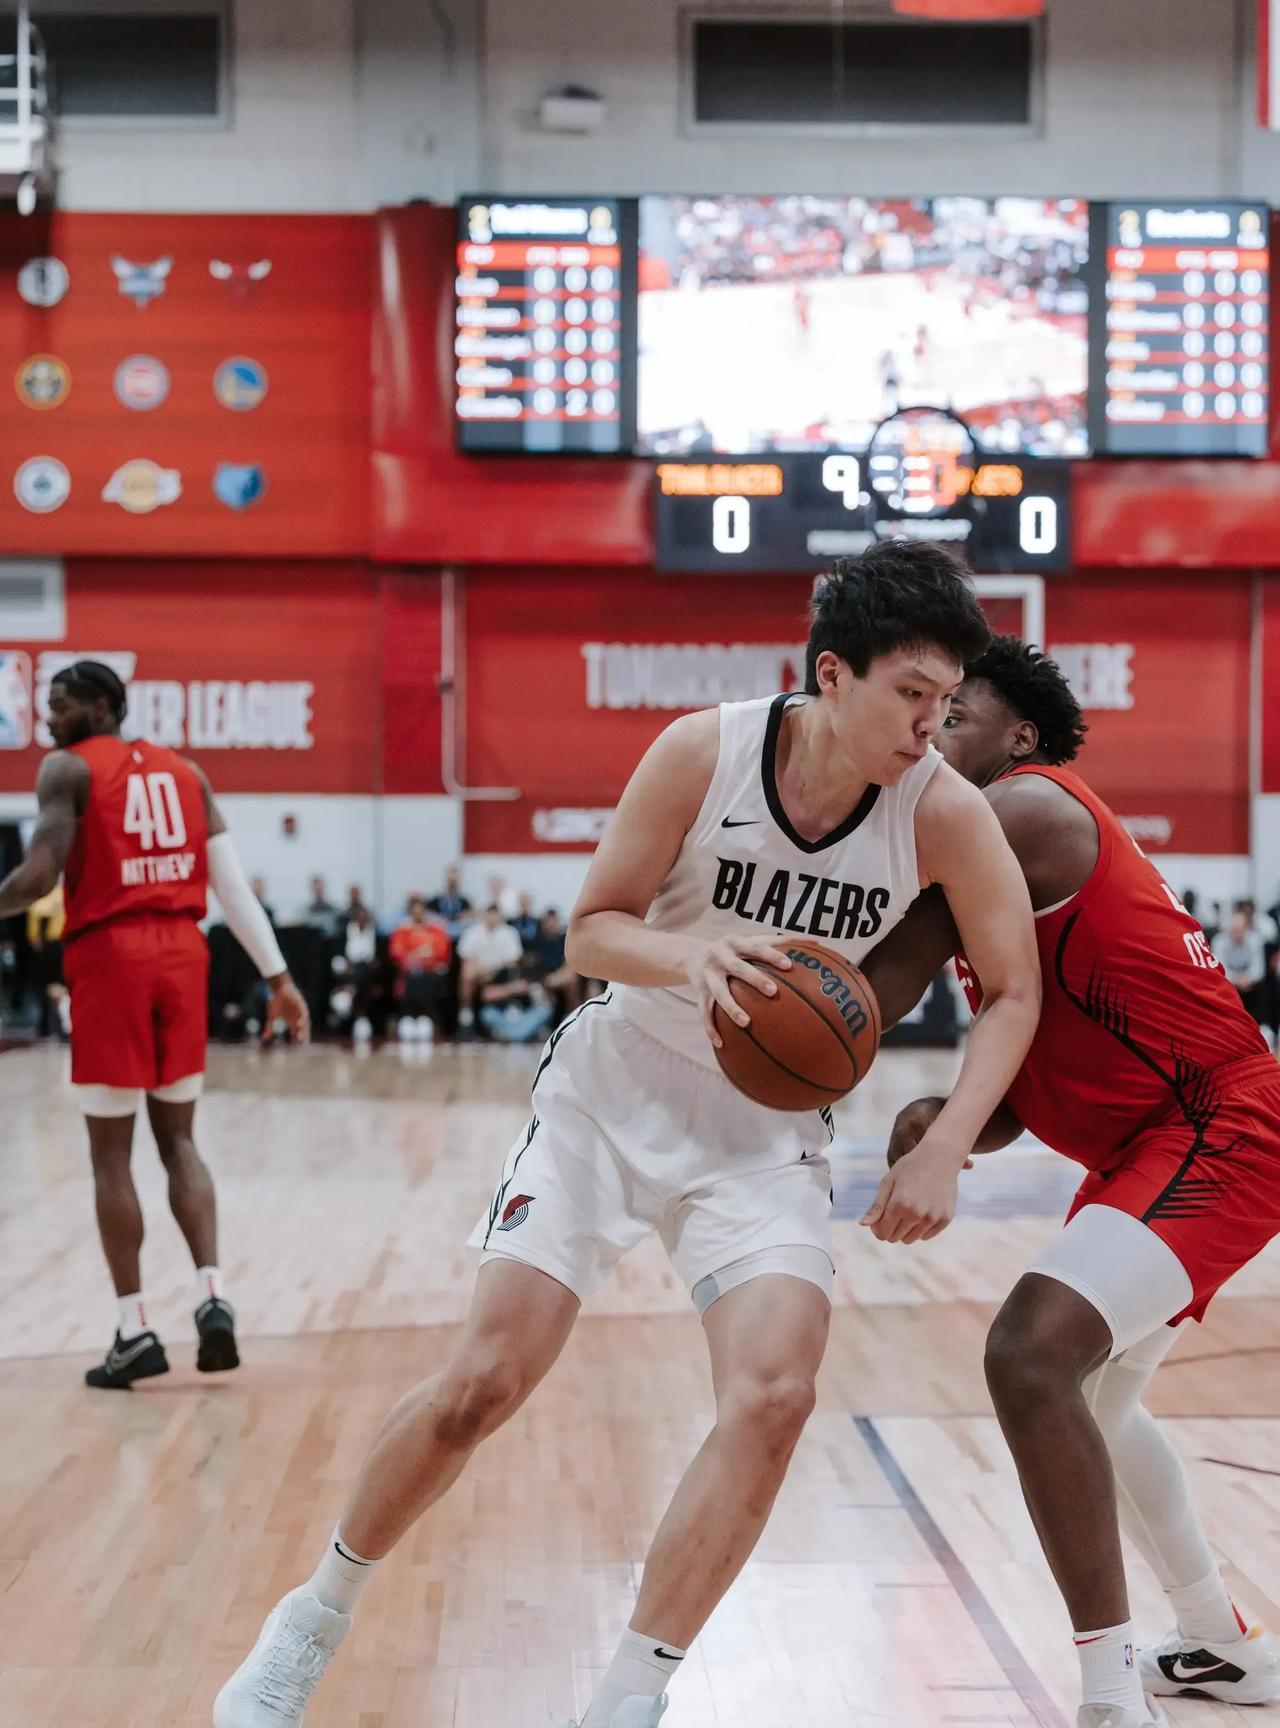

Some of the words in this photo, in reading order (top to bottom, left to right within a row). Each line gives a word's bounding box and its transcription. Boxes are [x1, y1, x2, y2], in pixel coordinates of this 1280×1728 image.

[713, 496, 750, 554] 0
[1020, 496, 1057, 554] 0
[123, 771, 187, 850] 40
[712, 856, 890, 940] BLAZERS
[786, 948, 868, 1040] Wilson
